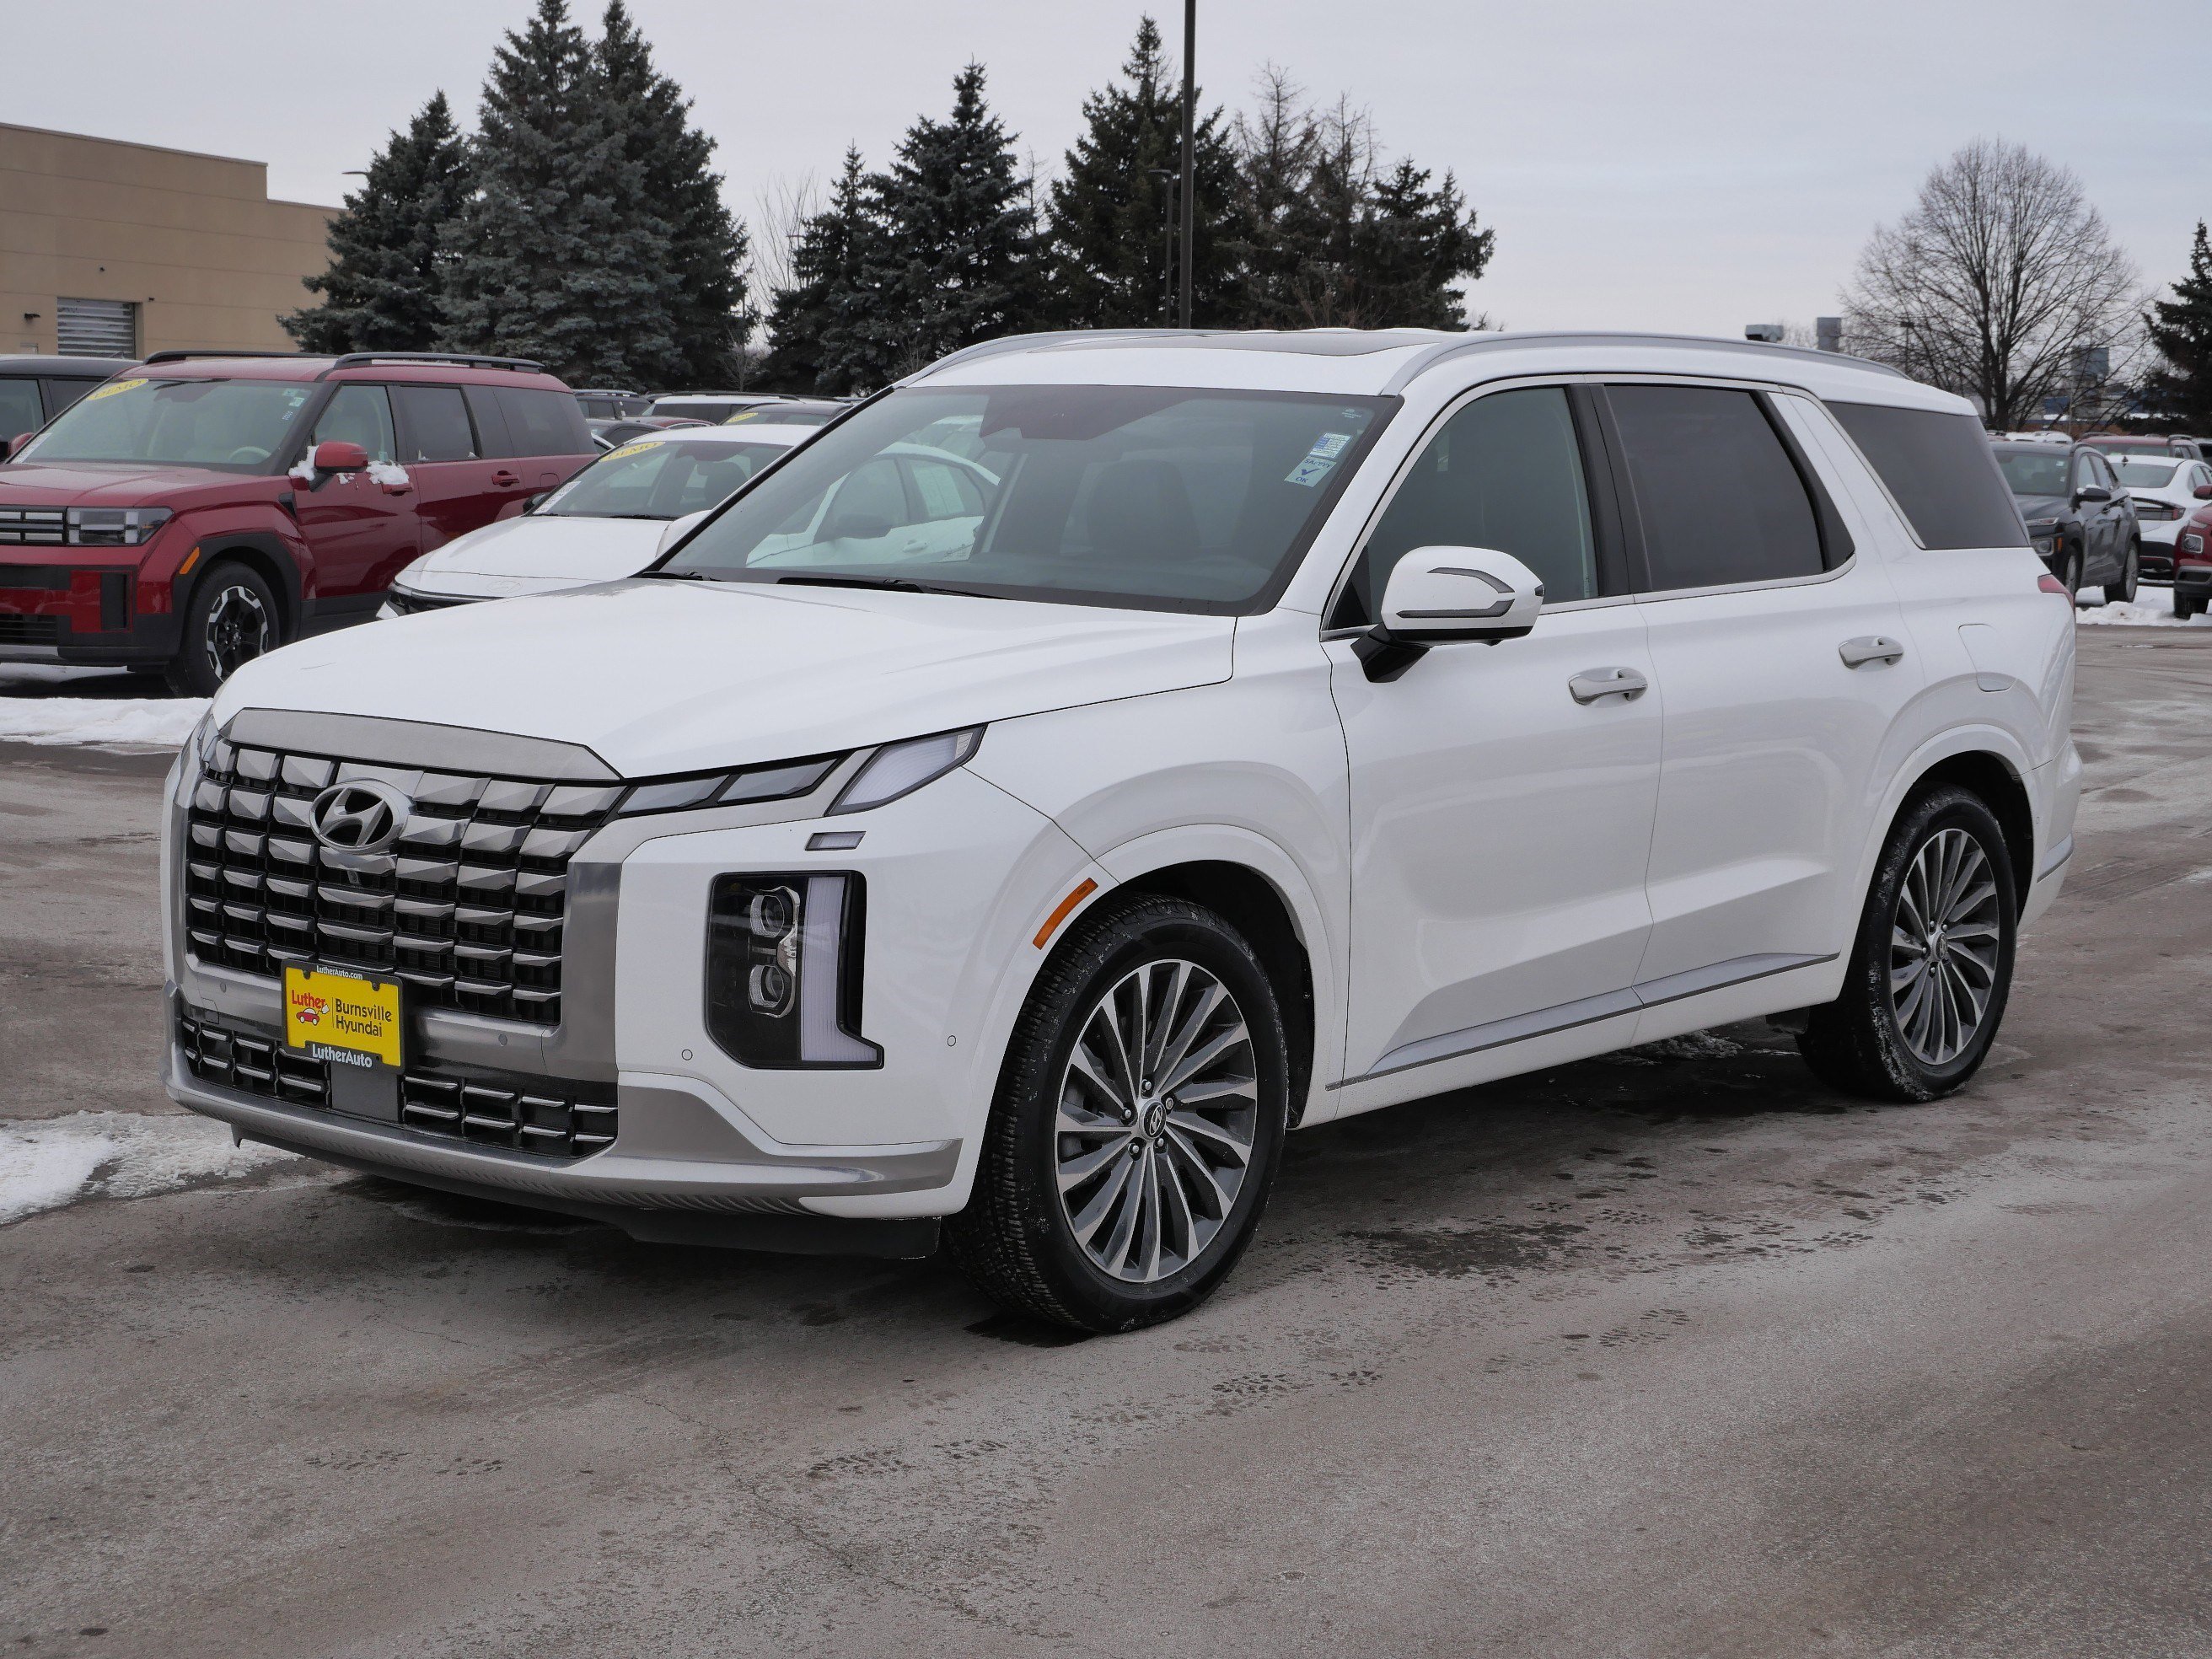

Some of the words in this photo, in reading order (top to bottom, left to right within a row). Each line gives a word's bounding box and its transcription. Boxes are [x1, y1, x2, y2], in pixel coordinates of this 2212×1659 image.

[94, 380, 142, 399] DEMO
[608, 442, 659, 459] DEMO
[1304, 459, 1332, 469] SAFETY
[316, 964, 363, 980] LutherAuto.com
[291, 989, 326, 1009] Luther
[335, 997, 392, 1023] Burnsville
[336, 1014, 383, 1038] Hyundai
[312, 1044, 373, 1068] LutherAuto
